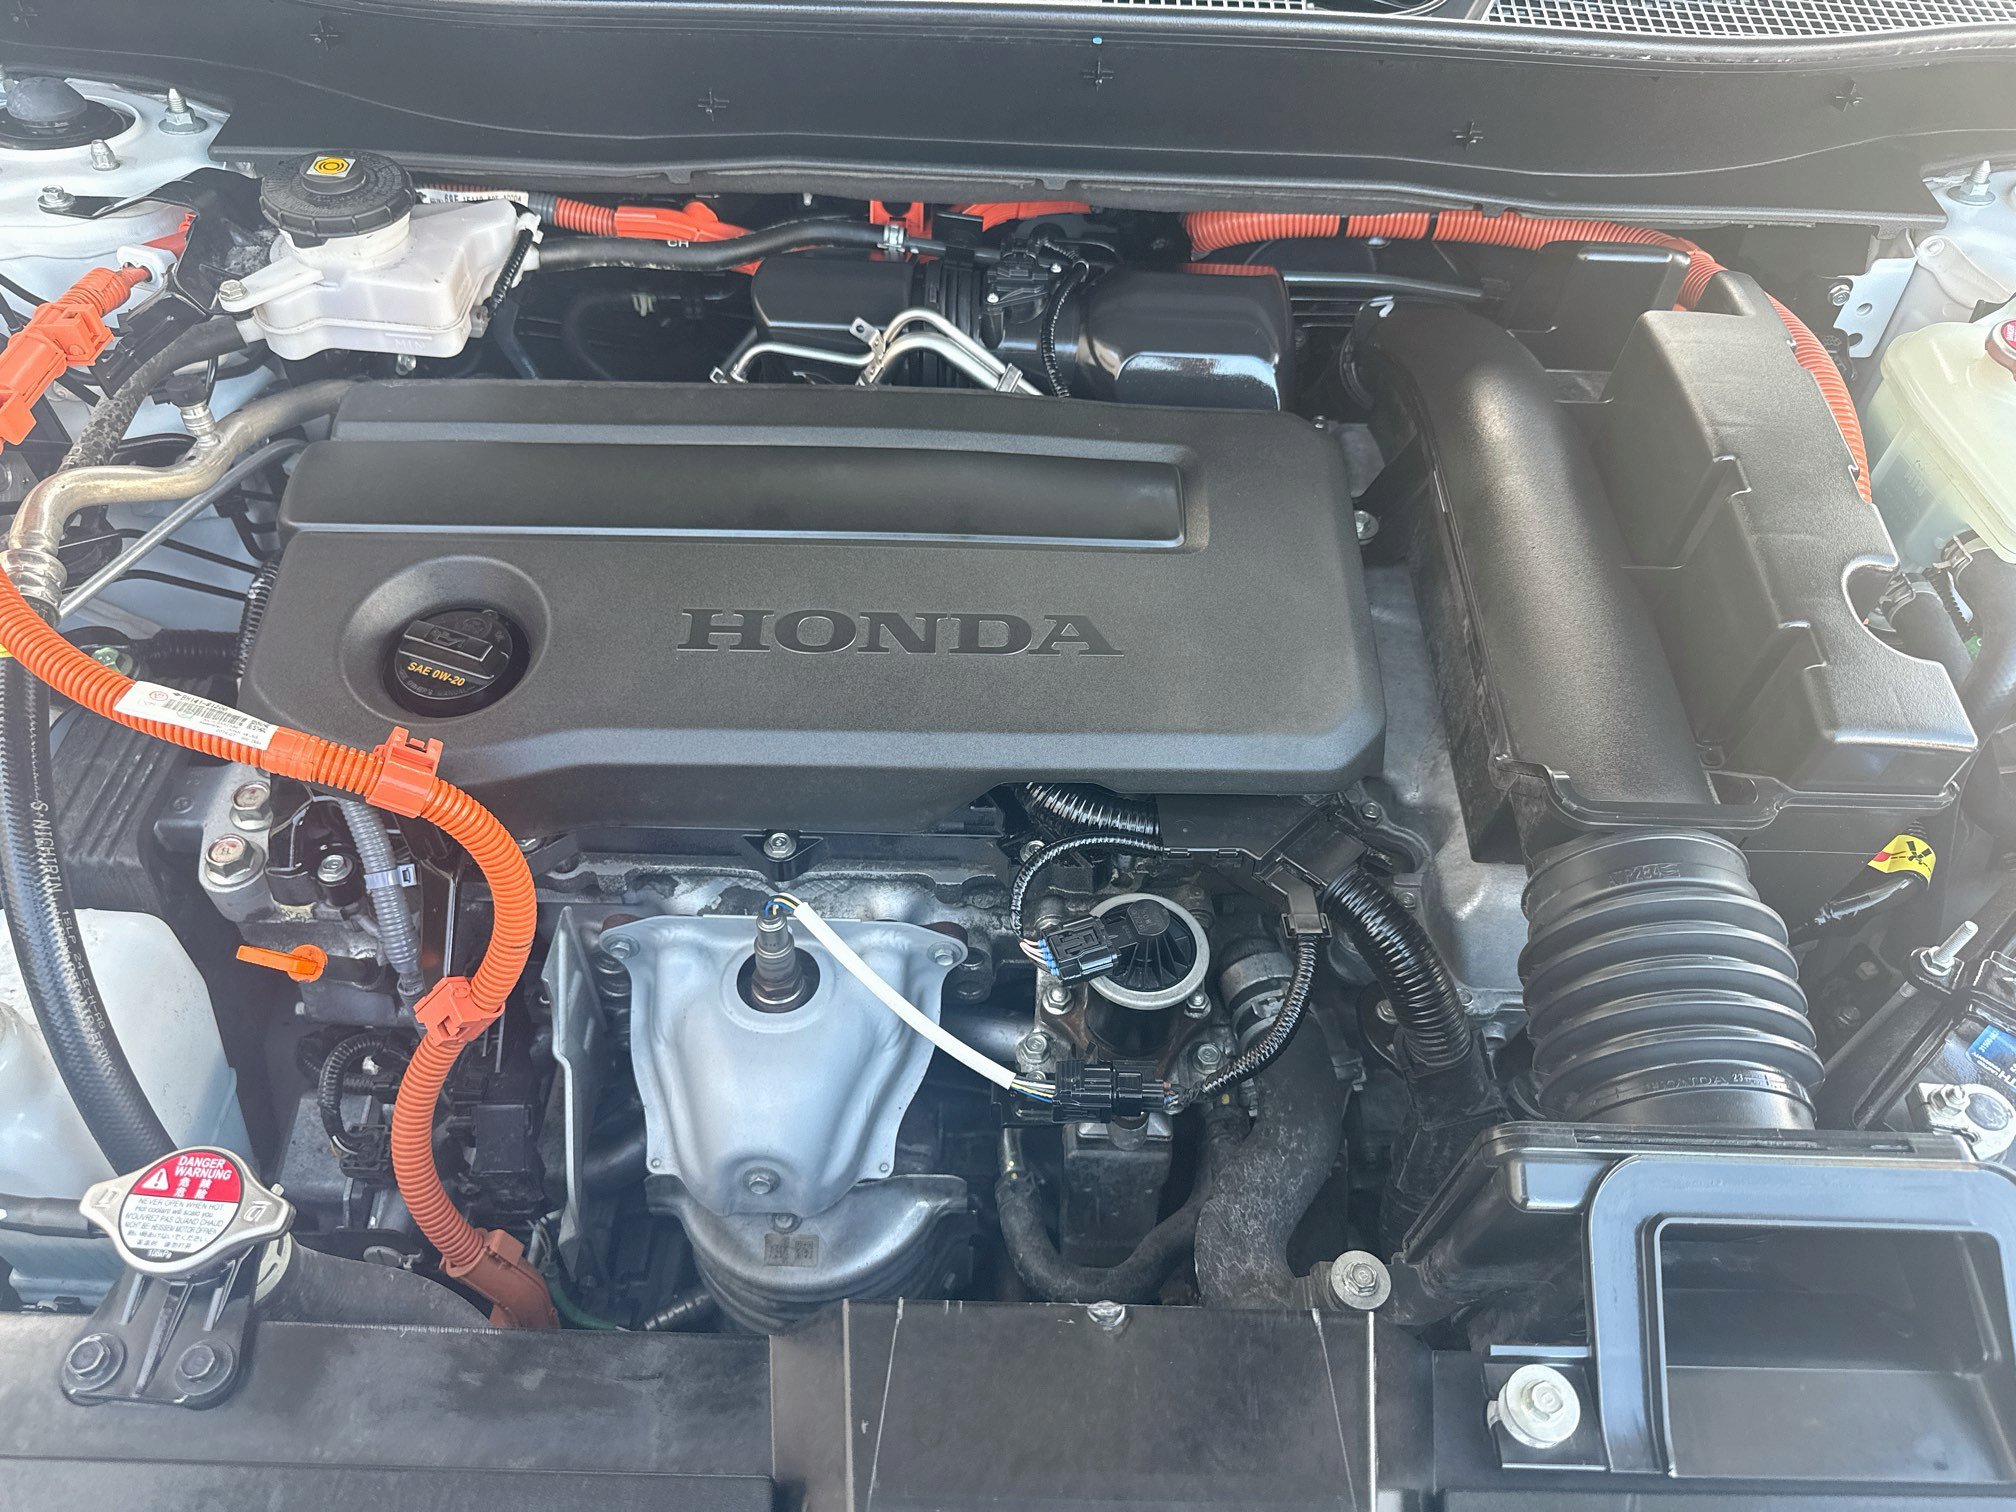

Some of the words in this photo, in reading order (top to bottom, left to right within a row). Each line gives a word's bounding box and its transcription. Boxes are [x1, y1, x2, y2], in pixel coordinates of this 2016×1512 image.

[676, 608, 1125, 657] HONDA
[407, 661, 433, 676] SAE
[431, 669, 466, 687] 0W-20
[178, 1155, 226, 1169] DANGER
[174, 1165, 233, 1181] WARNUNG
[164, 1199, 184, 1207] OPEN
[185, 1201, 207, 1209] WHEN
[208, 1203, 224, 1211] HOT
[159, 1215, 175, 1223] PAS
[174, 1217, 200, 1226] QUAND
[200, 1219, 224, 1227] CHAUD
[201, 1211, 213, 1219] you
